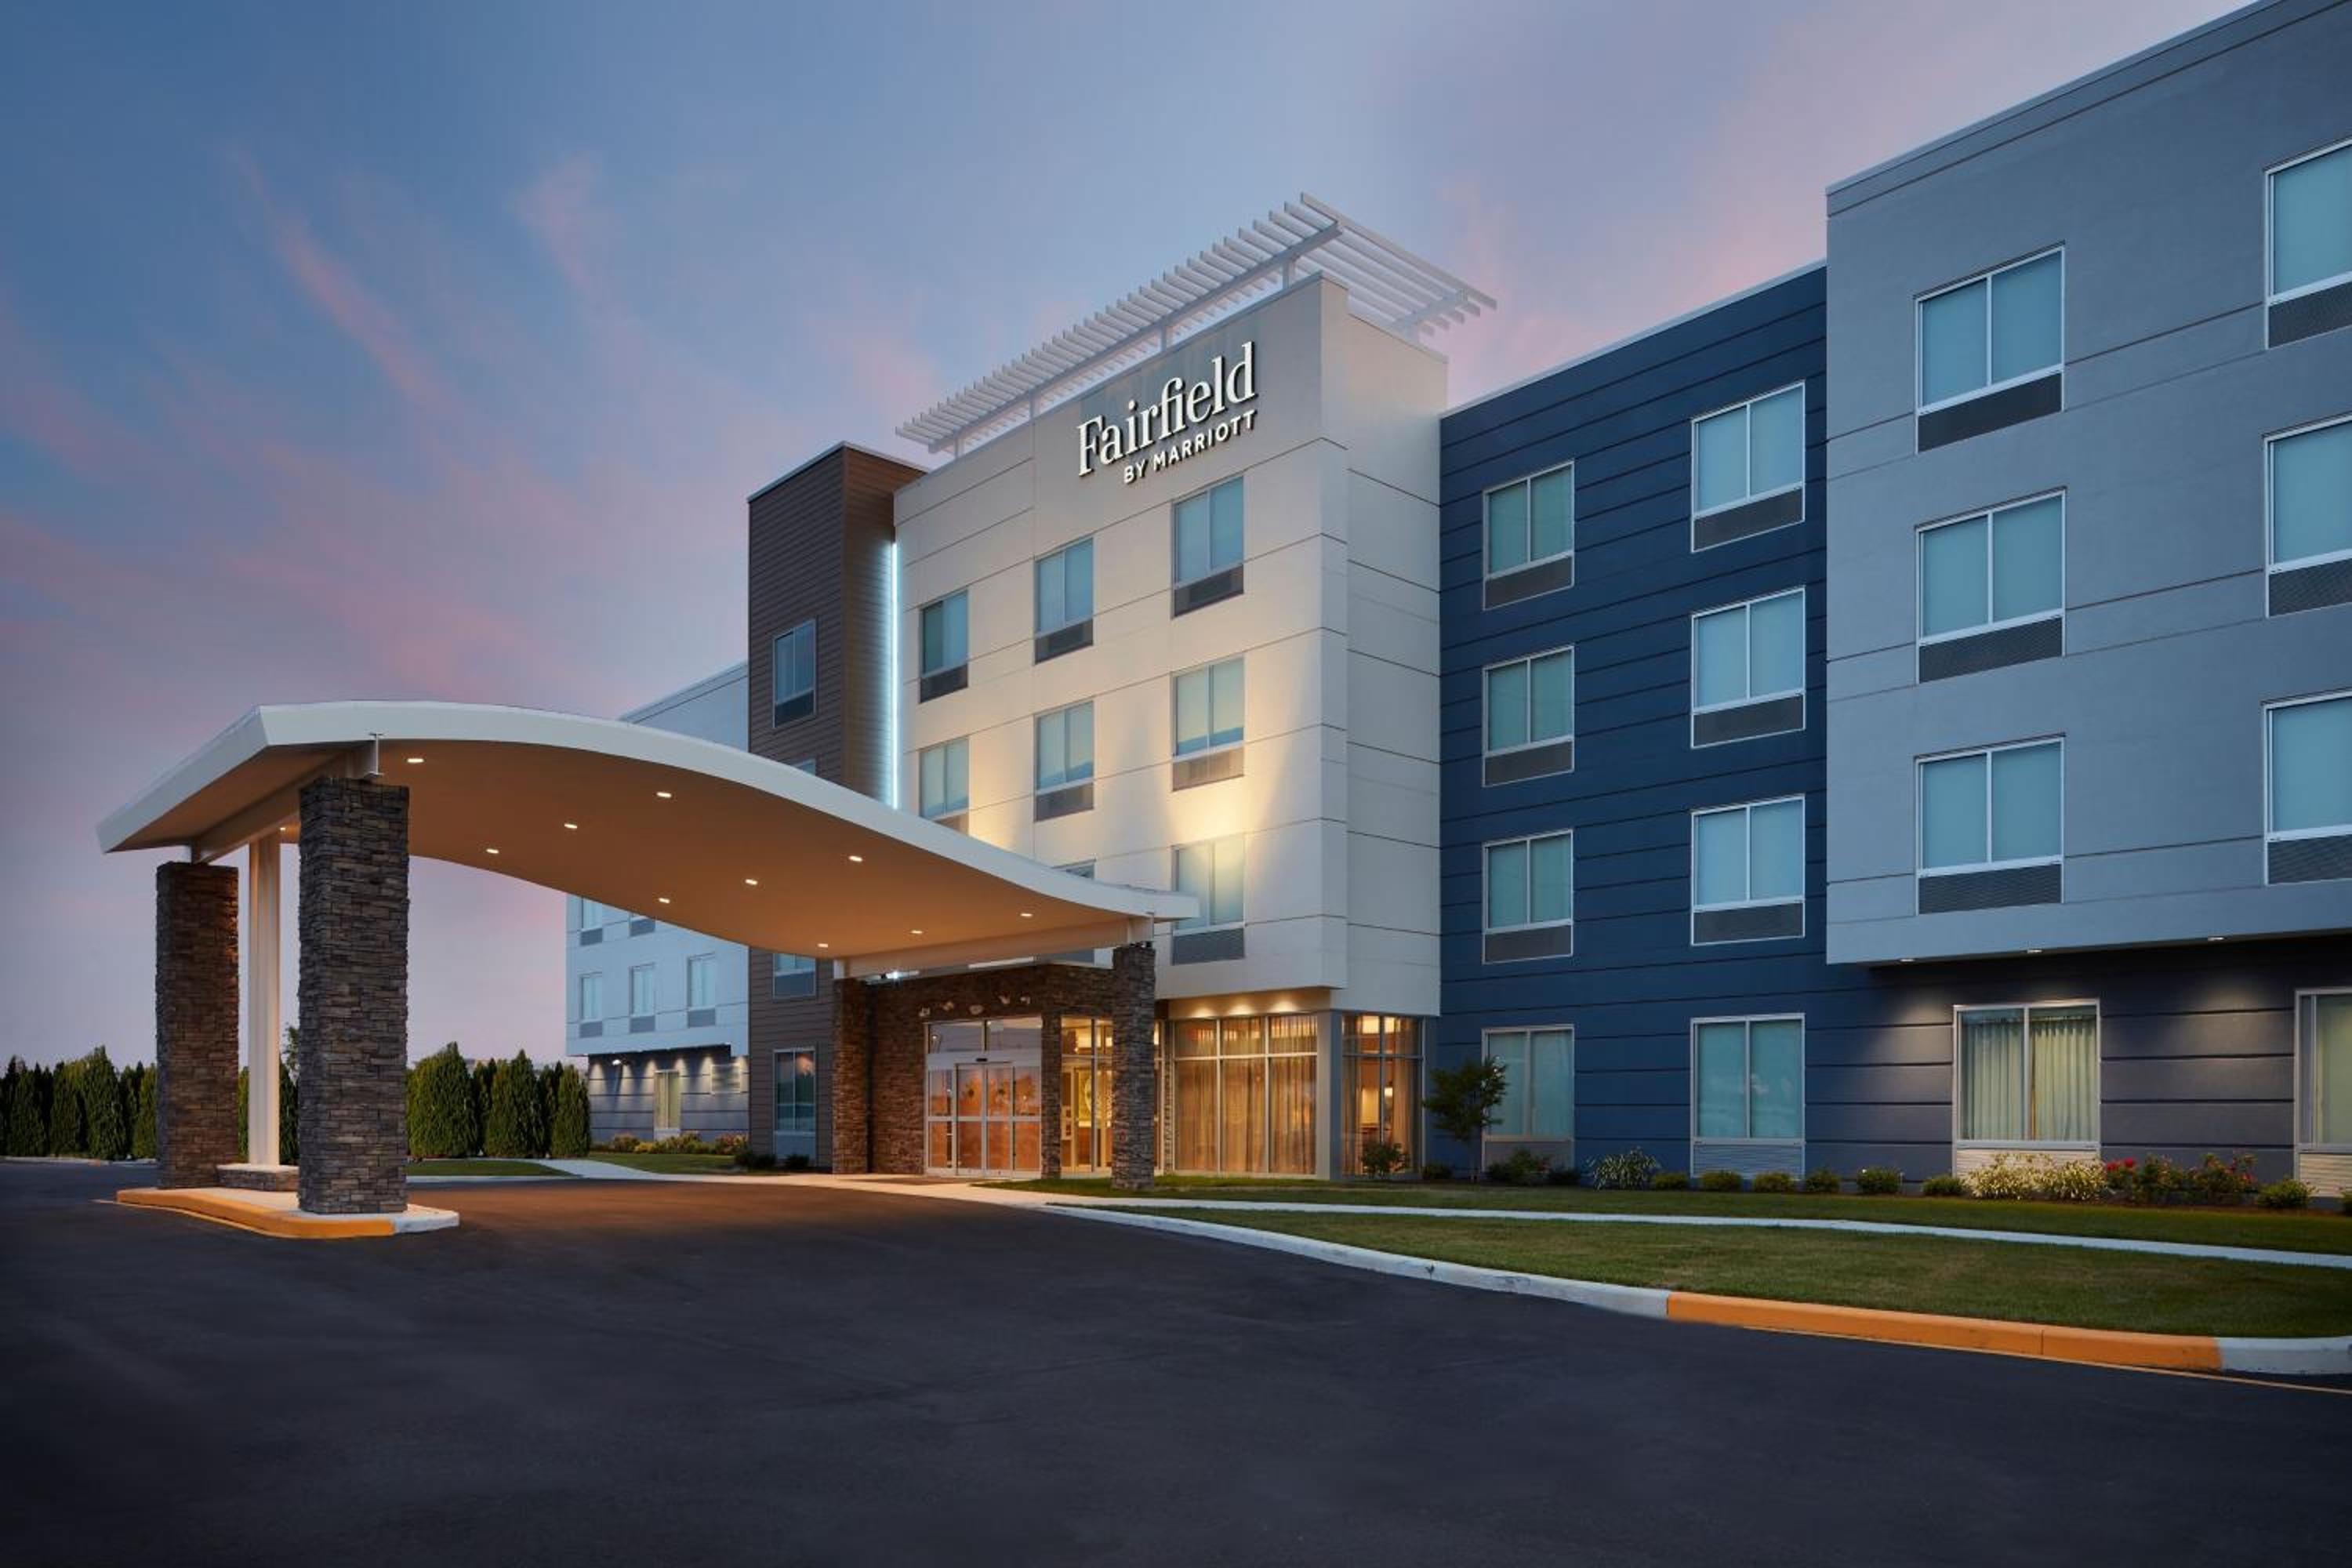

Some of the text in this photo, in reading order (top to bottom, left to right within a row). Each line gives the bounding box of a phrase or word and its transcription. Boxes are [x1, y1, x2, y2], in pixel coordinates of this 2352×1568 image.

[1076, 340, 1256, 477] Fairfield
[1123, 409, 1257, 484] BY MARRIOTT
